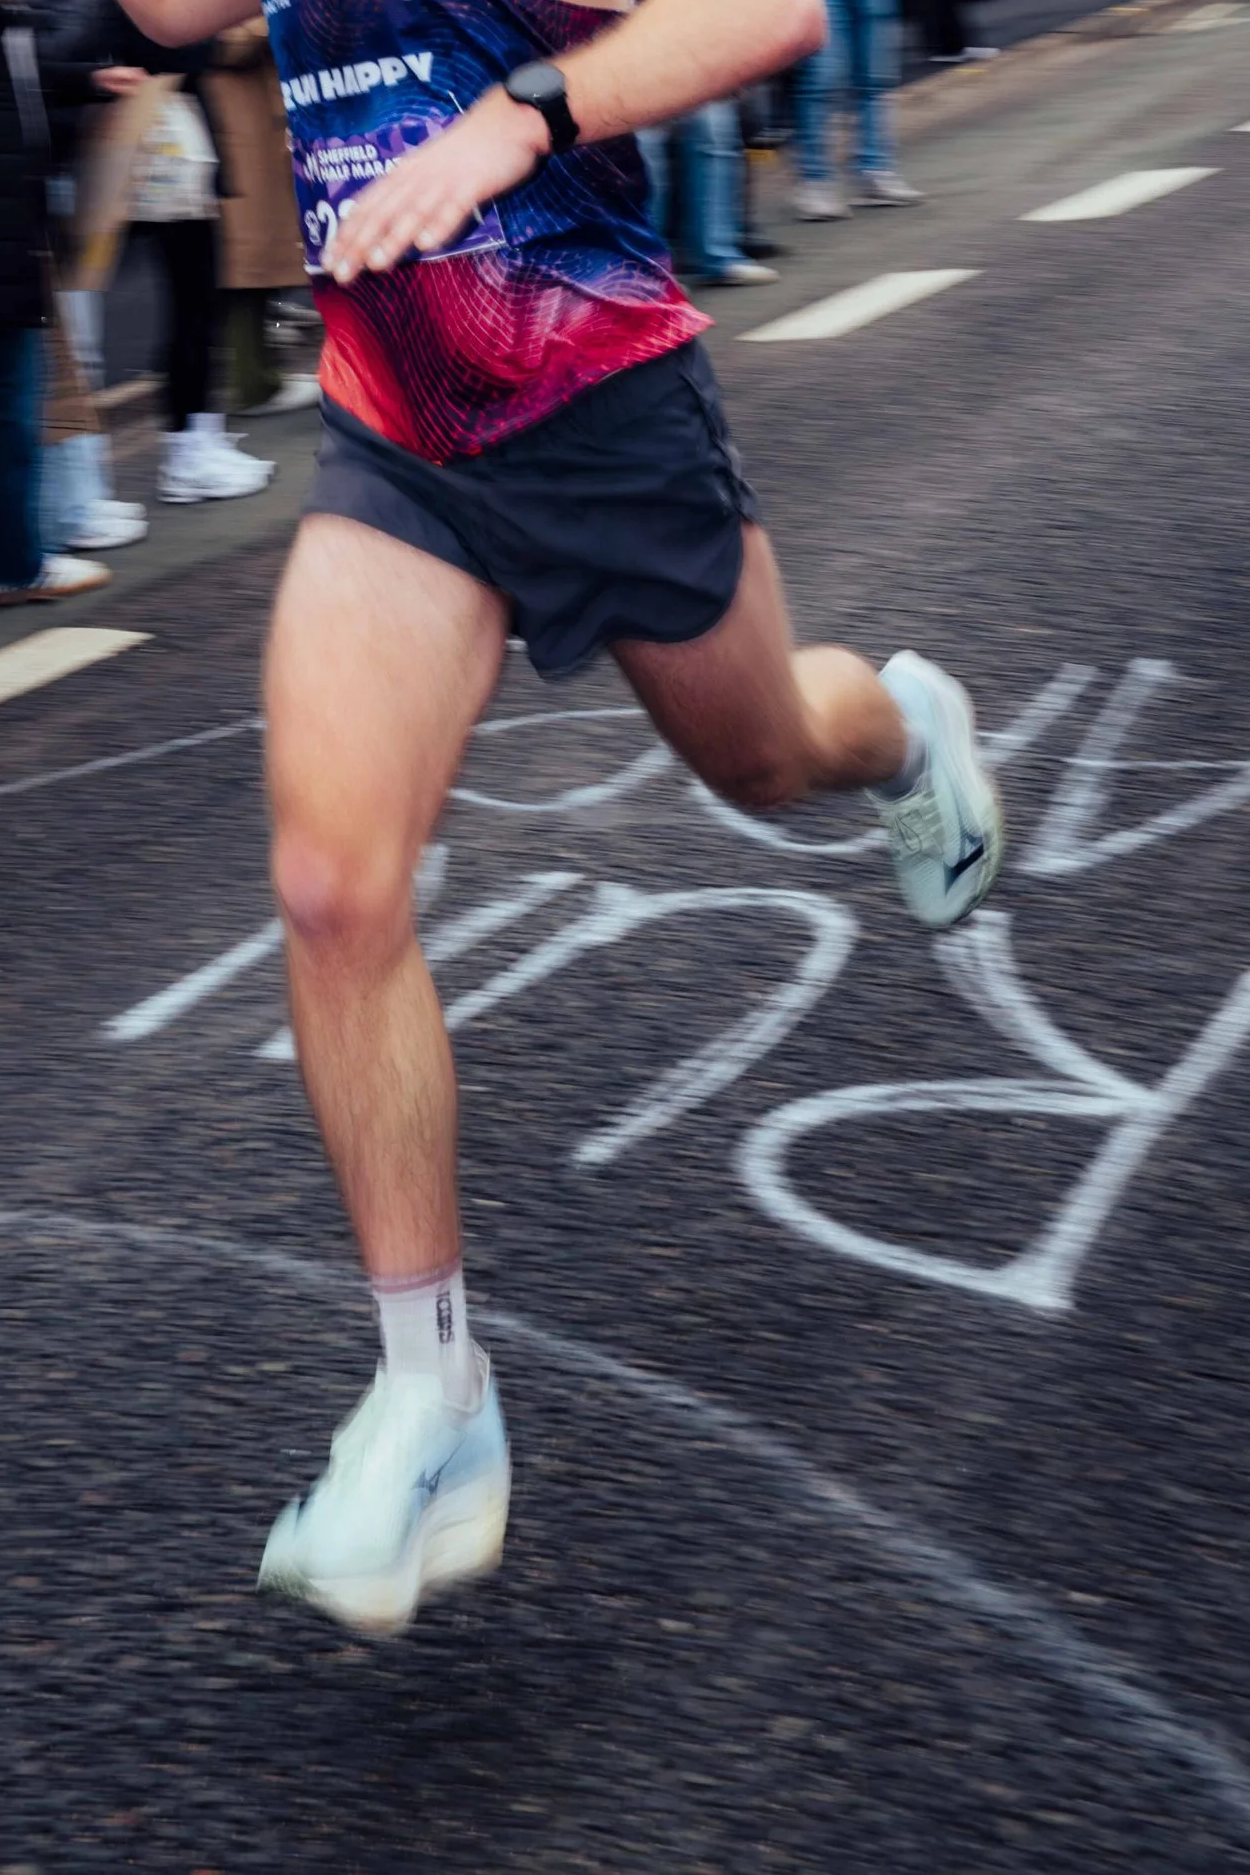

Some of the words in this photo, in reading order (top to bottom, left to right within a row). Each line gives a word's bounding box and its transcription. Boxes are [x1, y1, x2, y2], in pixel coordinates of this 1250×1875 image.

[317, 51, 434, 101] HAPPY
[317, 144, 378, 166] SHEFFIELD
[320, 165, 352, 182] HALF
